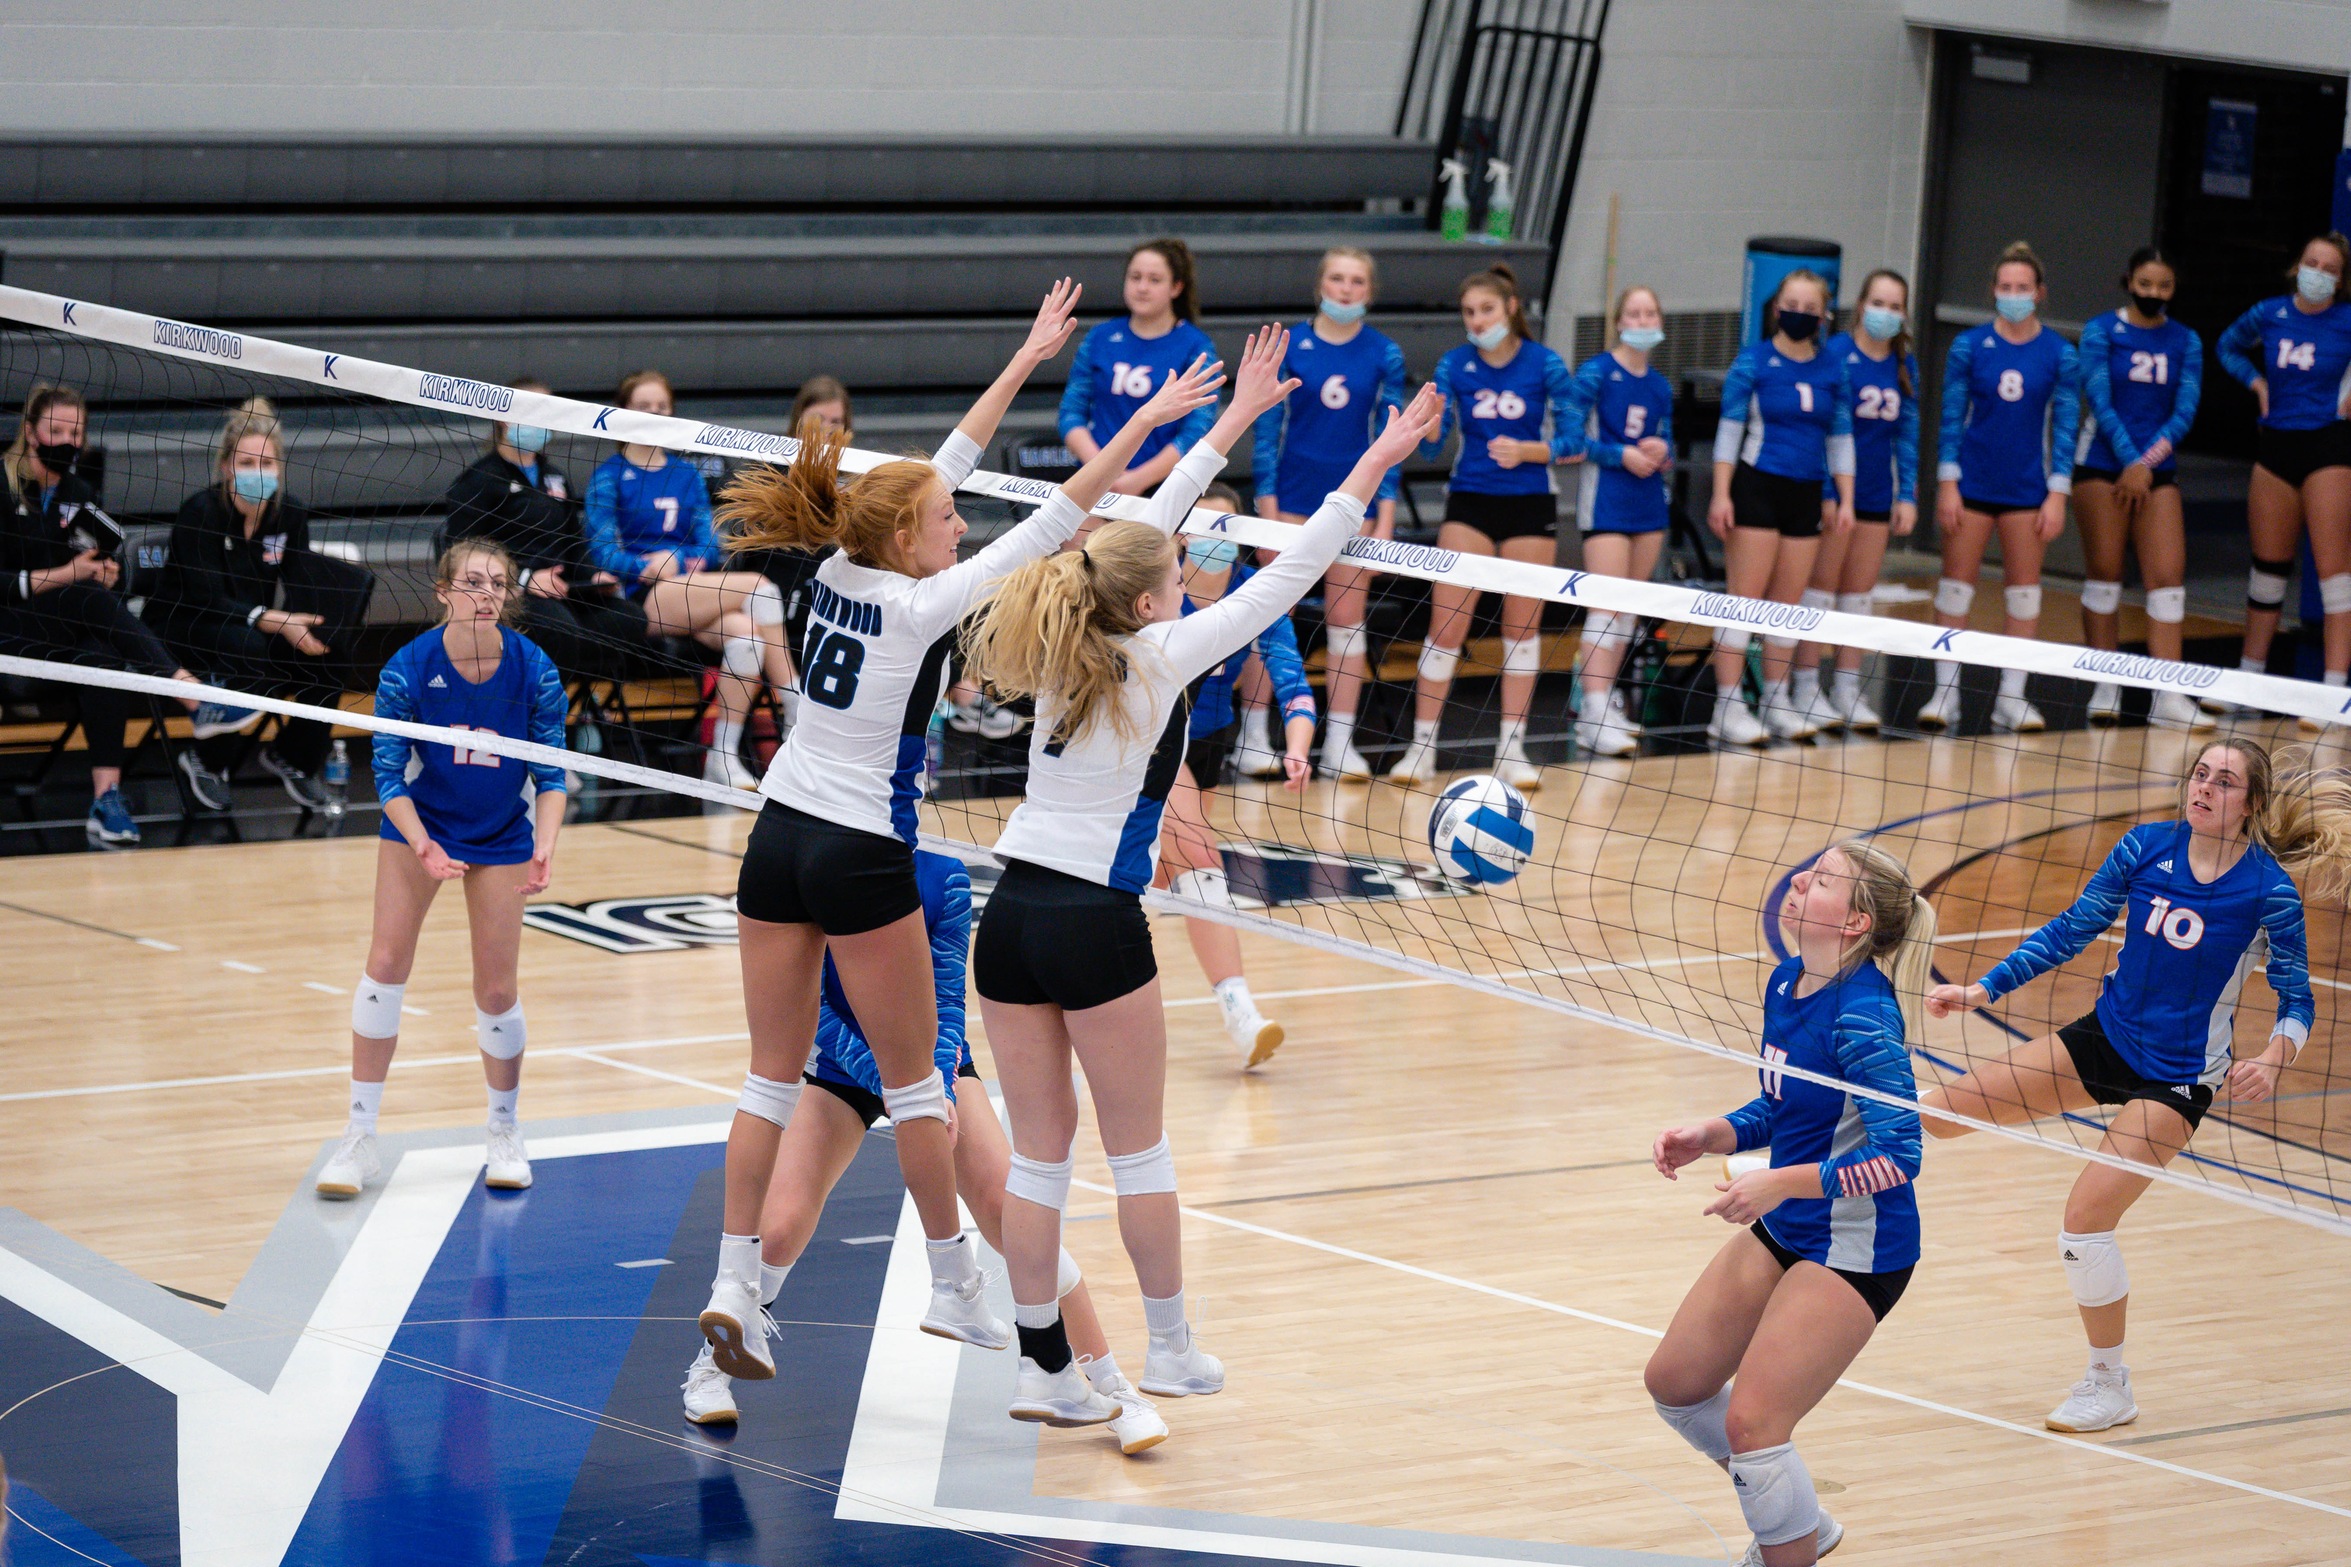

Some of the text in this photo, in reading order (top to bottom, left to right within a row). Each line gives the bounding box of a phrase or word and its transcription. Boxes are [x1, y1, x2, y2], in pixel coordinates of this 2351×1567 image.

[2128, 351, 2168, 385] 21
[2277, 338, 2316, 371] 14
[1111, 361, 1152, 398] 16
[1320, 374, 1350, 410] 6
[1795, 381, 1814, 412] 1
[1997, 369, 2024, 402] 8
[1472, 388, 1527, 420] 26
[1855, 385, 1901, 421] 23
[1624, 404, 1648, 439] 5
[63, 302, 78, 326] K
[153, 320, 242, 360] KIRKWOOD
[324, 355, 340, 380] K
[419, 373, 514, 412] KIRKWOOD
[592, 408, 617, 431] K
[694, 424, 803, 456] KIRKWOOD
[1341, 534, 1460, 573] KIRKWOOD
[1558, 572, 1589, 597] K
[1690, 592, 1826, 631] KIRKWOOD
[1931, 629, 1963, 652] K
[2073, 649, 2223, 688] KIRKWOOD
[653, 497, 680, 532] 7
[799, 621, 866, 711] 18
[450, 724, 501, 768] 12
[2144, 894, 2205, 951] 10
